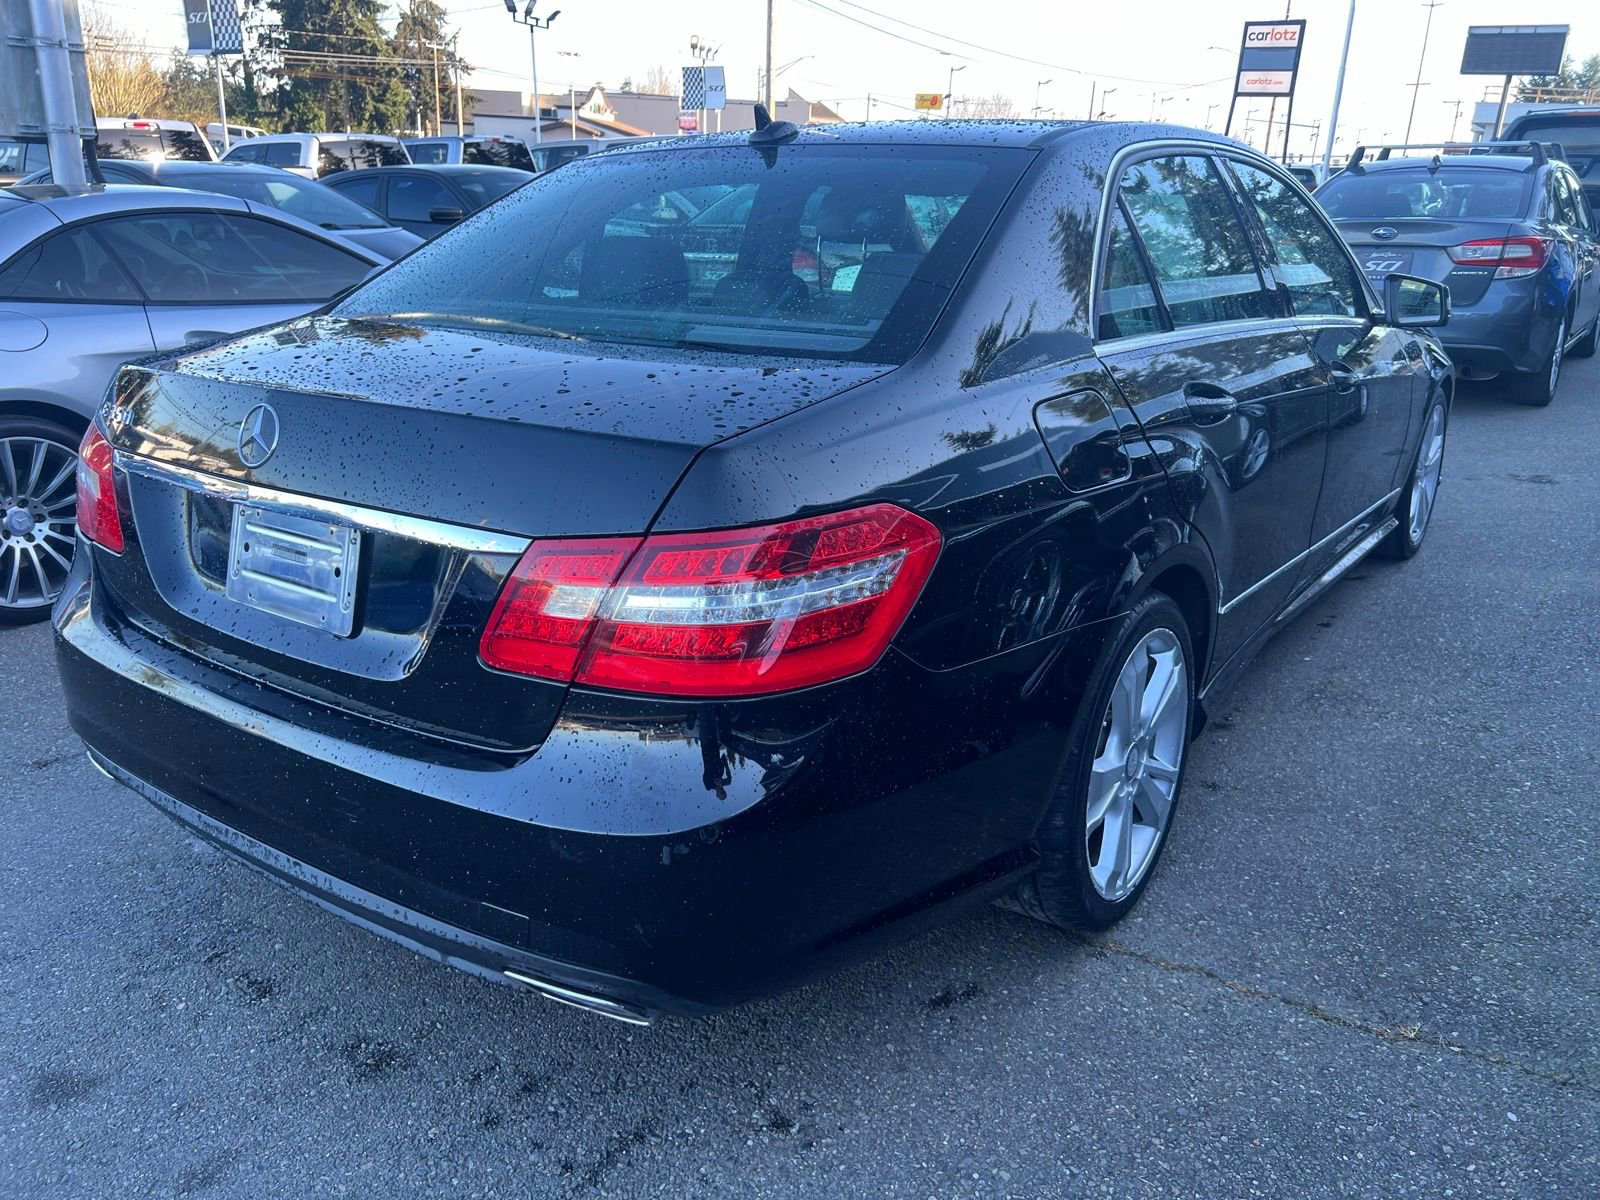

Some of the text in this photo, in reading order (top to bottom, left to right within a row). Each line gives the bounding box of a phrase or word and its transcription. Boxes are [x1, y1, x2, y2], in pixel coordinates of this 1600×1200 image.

[188, 12, 207, 24] SCI
[1248, 28, 1297, 41] carlotz
[1364, 260, 1404, 271] SCI
